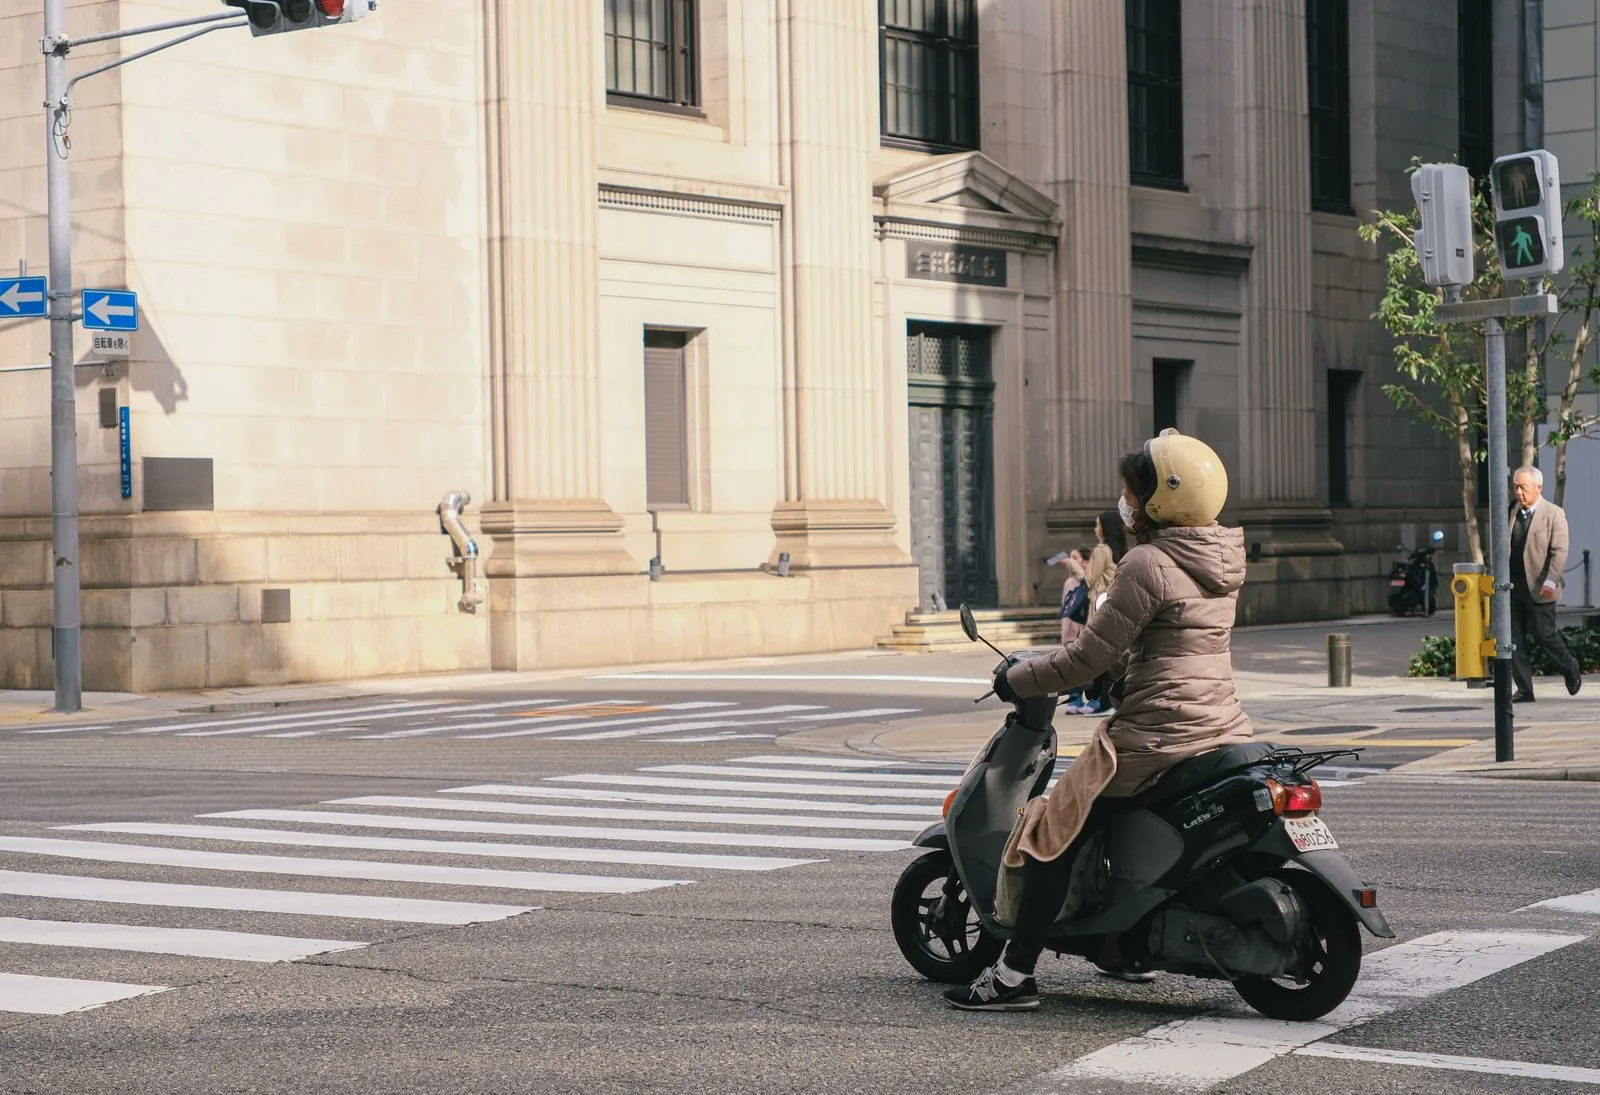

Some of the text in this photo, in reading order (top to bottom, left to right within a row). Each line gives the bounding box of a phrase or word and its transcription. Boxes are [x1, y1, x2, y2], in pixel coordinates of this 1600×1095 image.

[94, 337, 129, 350] 自転車を除く
[1300, 828, 1334, 847] 80256
